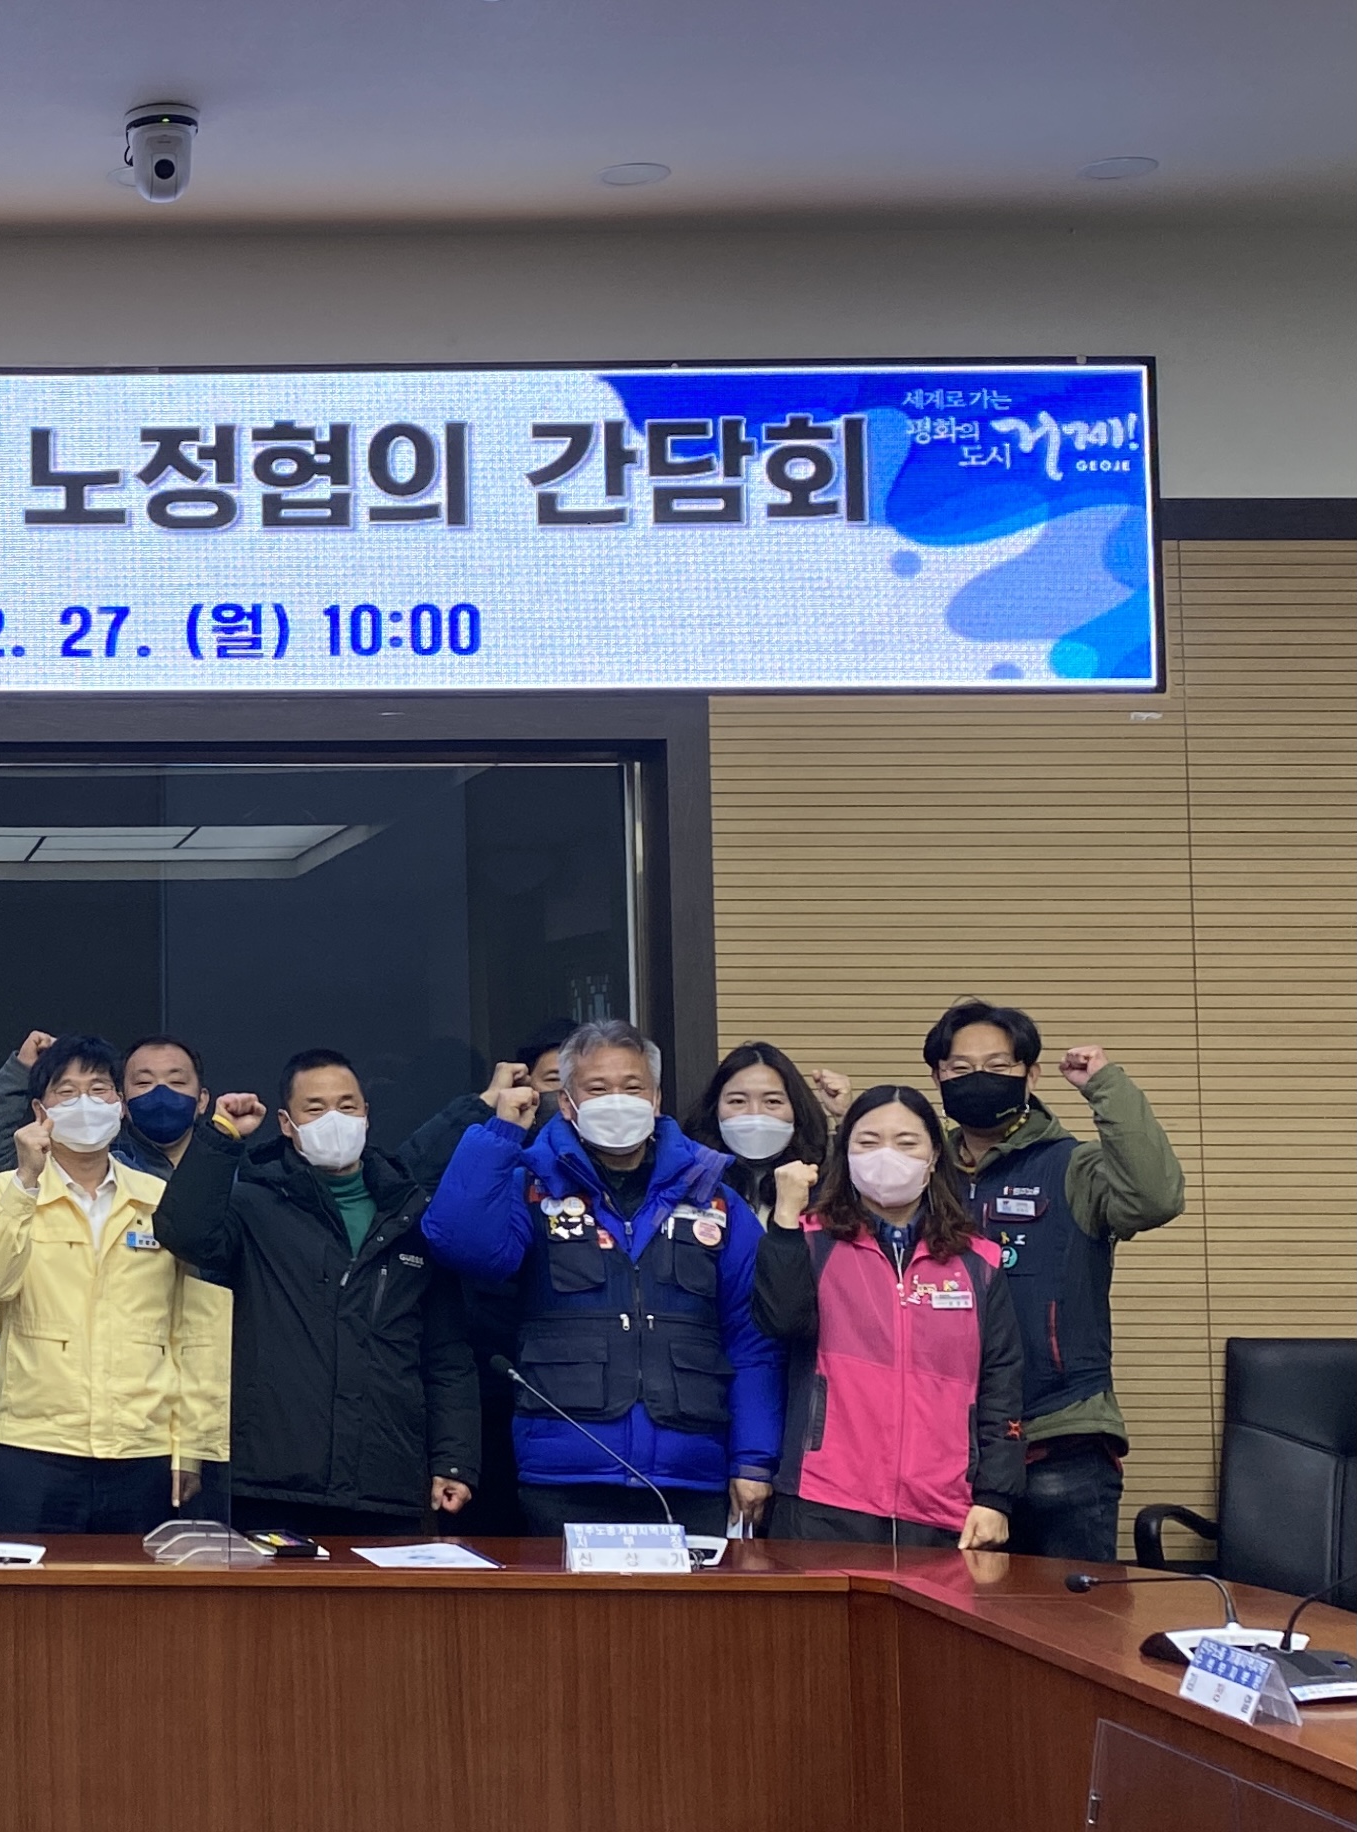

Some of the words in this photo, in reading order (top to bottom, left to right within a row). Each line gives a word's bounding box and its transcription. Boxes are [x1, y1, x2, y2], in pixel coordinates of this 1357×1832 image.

[901, 388, 967, 411] 세계로
[968, 388, 1012, 411] 가는
[906, 416, 981, 445] 평화의
[958, 442, 1011, 470] 도시
[1075, 459, 1131, 472] GEOJE
[22, 418, 469, 531] 노정협의
[524, 413, 871, 527] 간담회
[58, 604, 151, 658] 27.
[184, 602, 290, 662] (월)
[322, 603, 482, 657] 10:00
